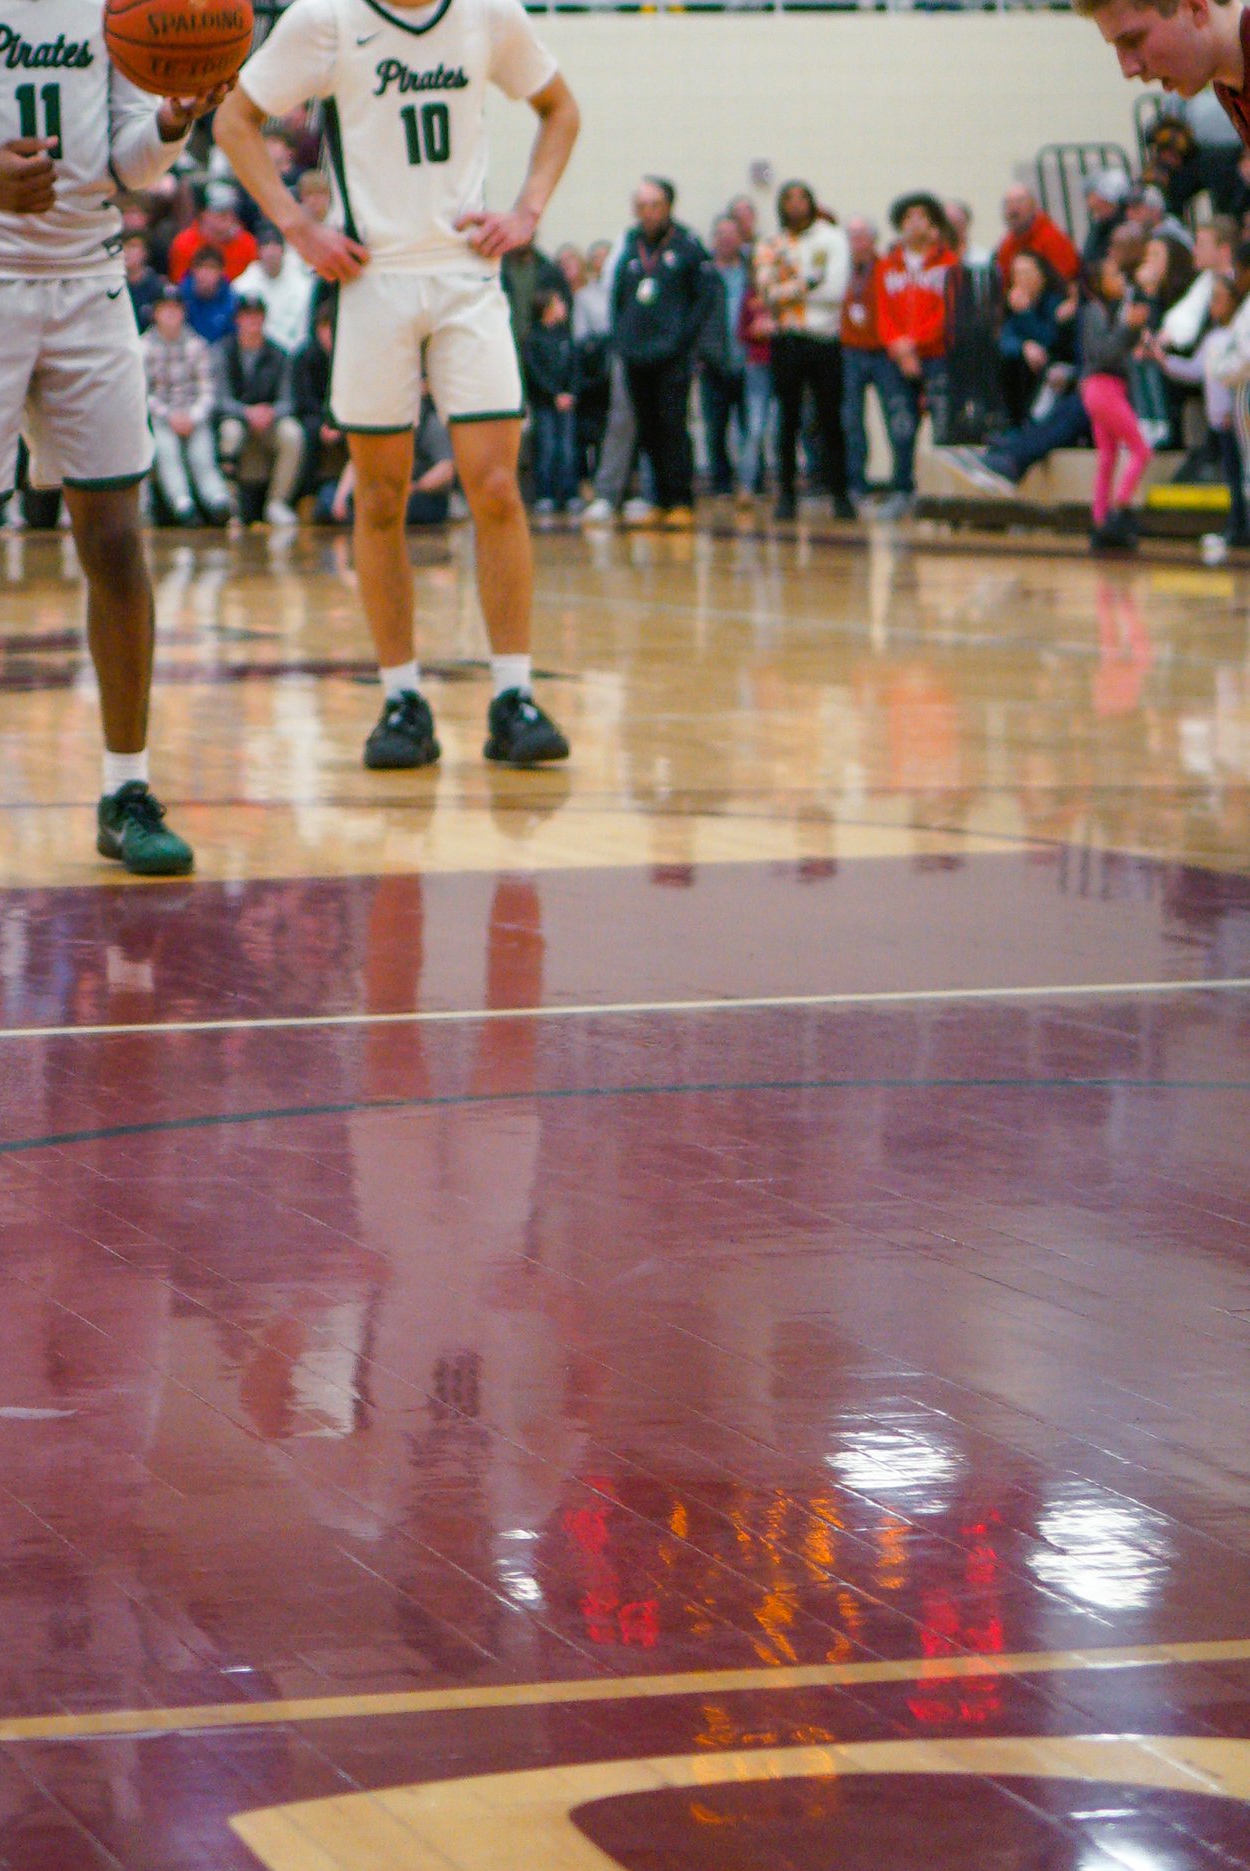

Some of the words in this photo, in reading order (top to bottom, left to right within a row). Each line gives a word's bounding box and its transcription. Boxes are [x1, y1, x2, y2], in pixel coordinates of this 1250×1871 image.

[373, 57, 469, 96] Pirates
[15, 82, 63, 159] 11
[400, 101, 451, 166] 10
